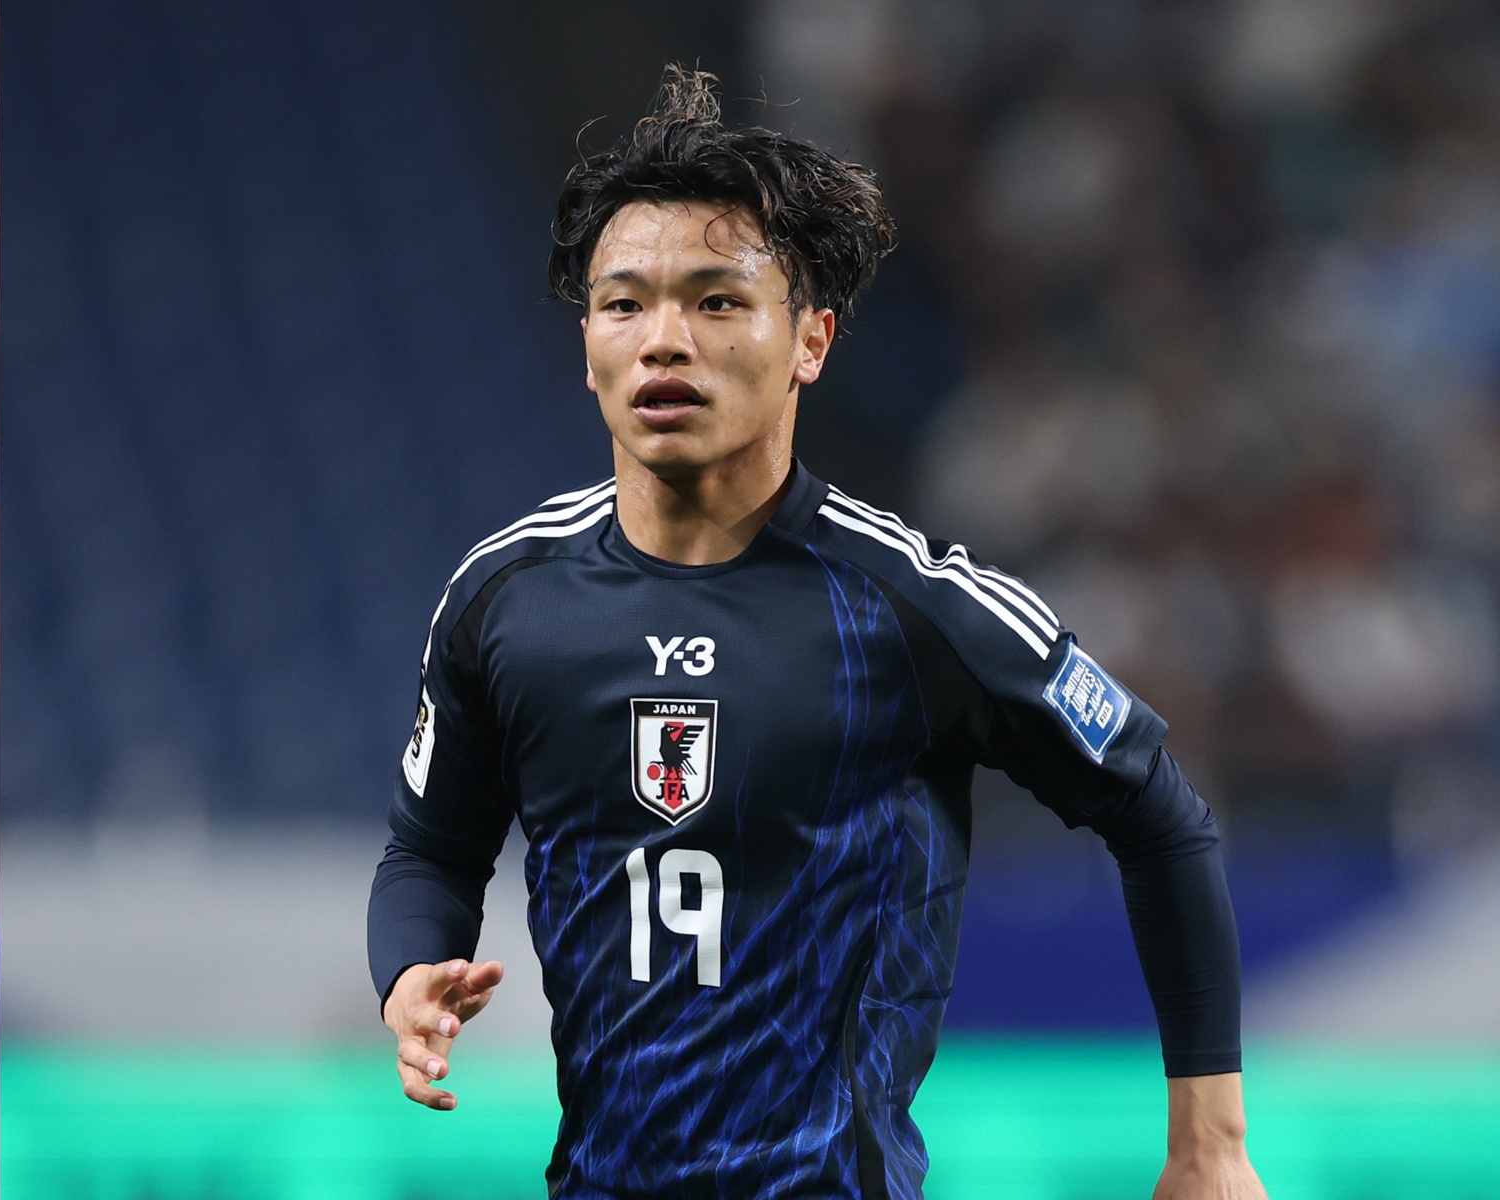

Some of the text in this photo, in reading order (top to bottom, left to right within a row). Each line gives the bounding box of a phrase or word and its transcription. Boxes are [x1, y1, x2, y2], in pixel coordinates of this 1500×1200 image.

[645, 636, 716, 677] Y-3
[1062, 658, 1086, 698] FOOTBALL
[1071, 667, 1096, 713] UNITES
[653, 704, 696, 715] JAPAN
[655, 782, 690, 801] JFA
[626, 847, 724, 988] 19
